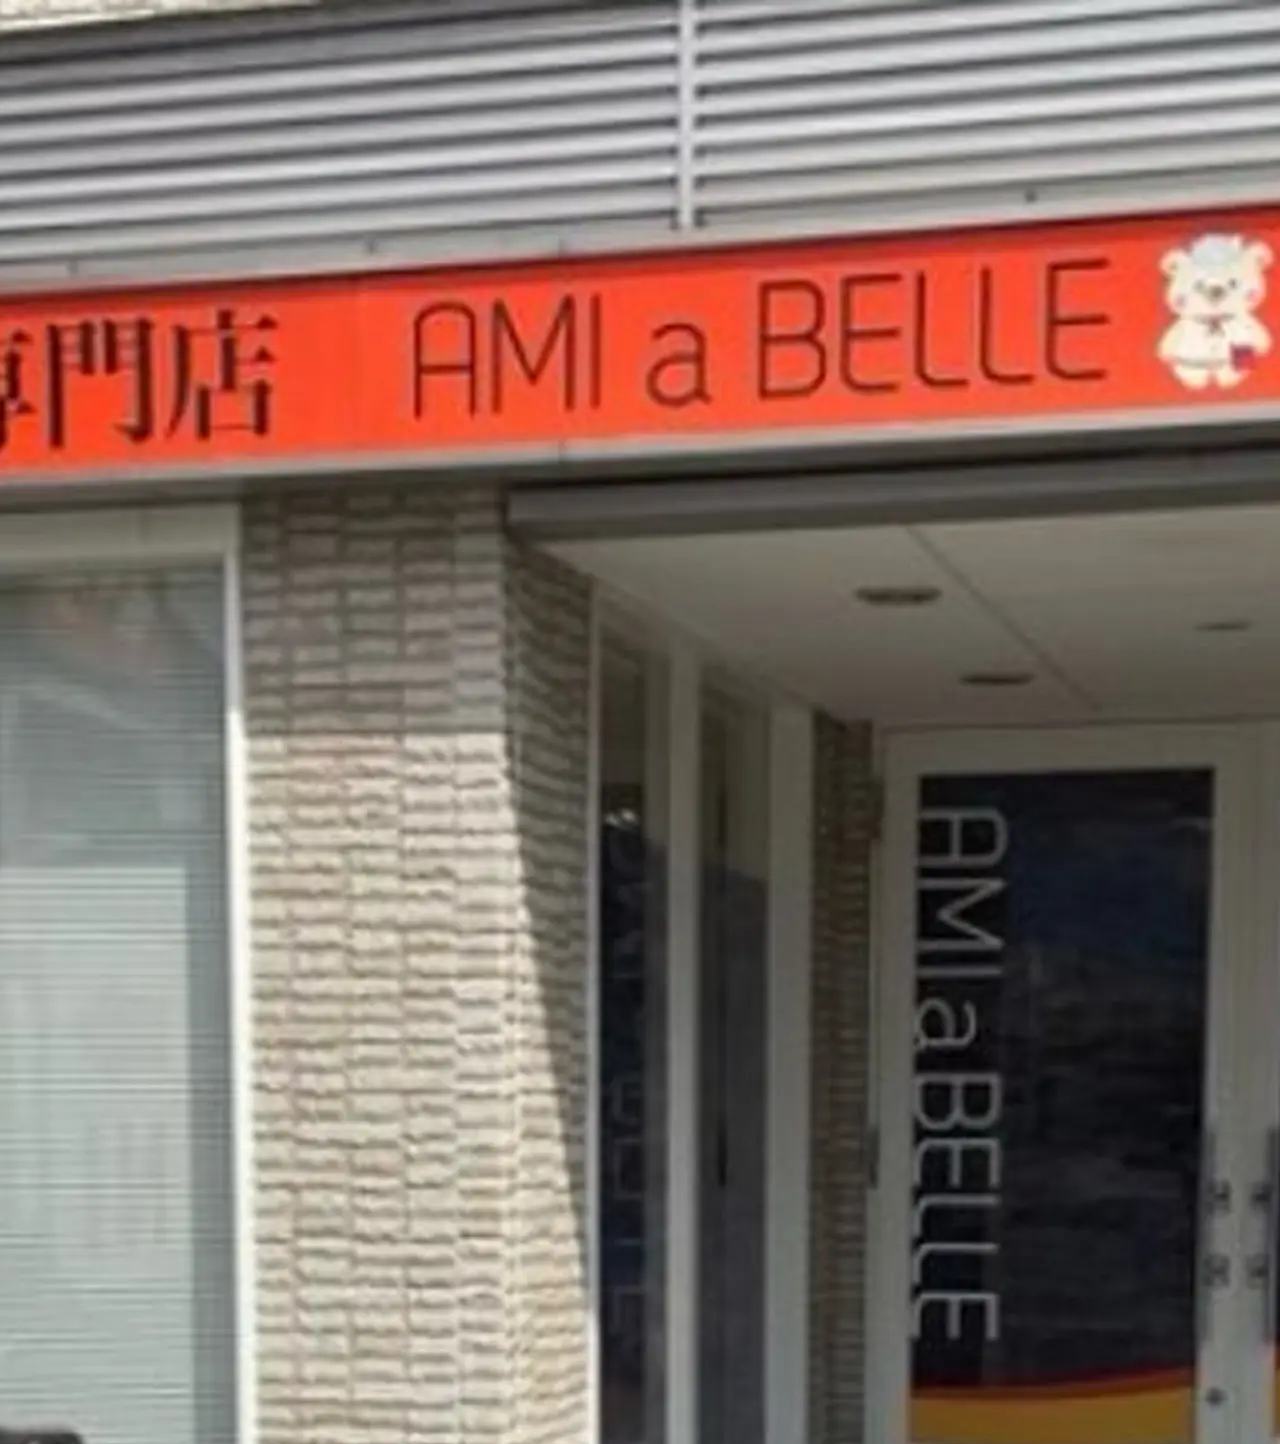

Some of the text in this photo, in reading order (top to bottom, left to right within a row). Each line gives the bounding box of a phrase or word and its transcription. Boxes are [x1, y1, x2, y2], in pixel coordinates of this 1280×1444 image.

[412, 257, 1111, 419] AMI a BELLE
[910, 808, 1008, 1341] AMI a BELLE
